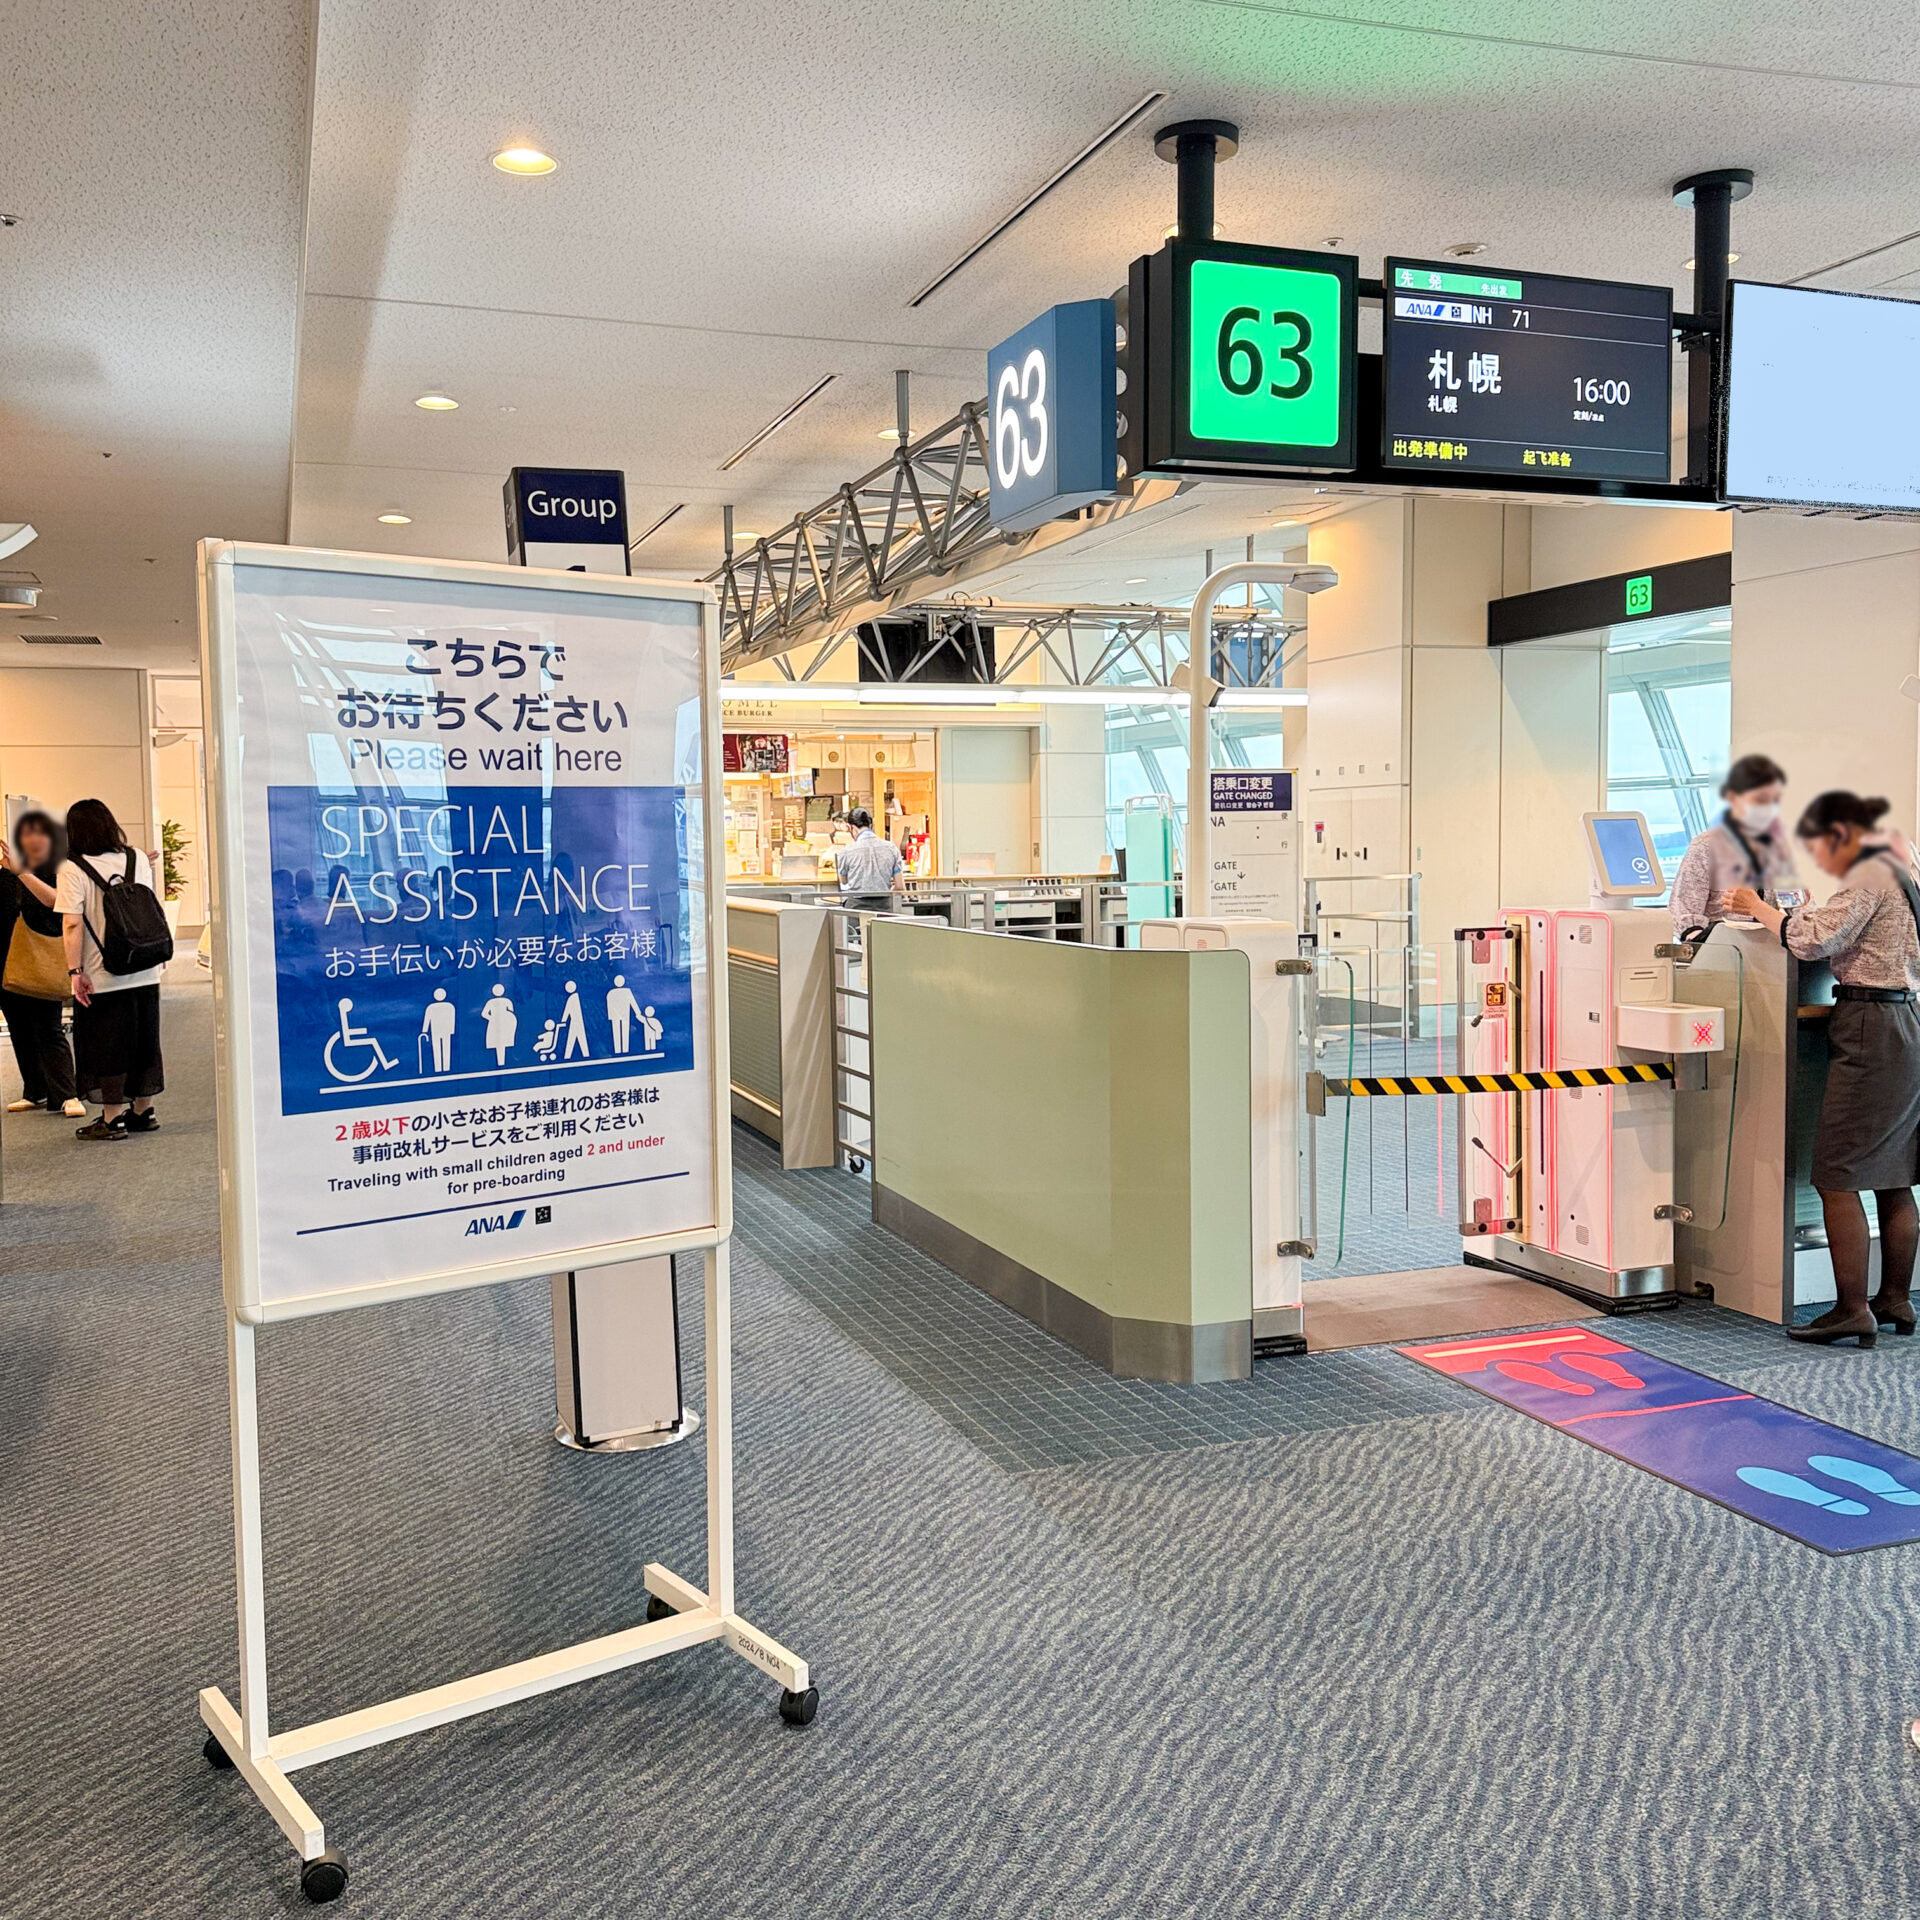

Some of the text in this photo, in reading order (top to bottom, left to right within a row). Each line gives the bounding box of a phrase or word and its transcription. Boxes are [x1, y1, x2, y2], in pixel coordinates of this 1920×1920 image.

[1406, 303, 1530, 329] ANA NH 71
[1217, 306, 1314, 400] 63
[1427, 349, 1502, 394] 札幌
[1573, 376, 1631, 406] 16:00
[996, 349, 1048, 489] 63
[1393, 440, 1468, 461] 出発準備中
[1523, 450, 1572, 468] 起飞准备
[527, 490, 617, 525] Group
[1630, 584, 1649, 607] 63
[405, 637, 567, 681] こちらで
[337, 687, 629, 733] お待ちください
[350, 738, 623, 771] Please wait here
[1213, 792, 1273, 800] GATE CHANGED
[321, 804, 545, 860] SPECIAL
[1214, 861, 1237, 870] GATE
[324, 863, 651, 925] ASSISTANCE
[1214, 882, 1237, 891] GATE
[325, 929, 657, 979] お手伝いが必要なお客様
[352, 1113, 644, 1165] 事前改札サービスをご利用ください
[328, 1135, 665, 1192] Traveling with small children aged 2 and under
[448, 1169, 565, 1195] for pre-boarding
[464, 1214, 506, 1236] ANA
